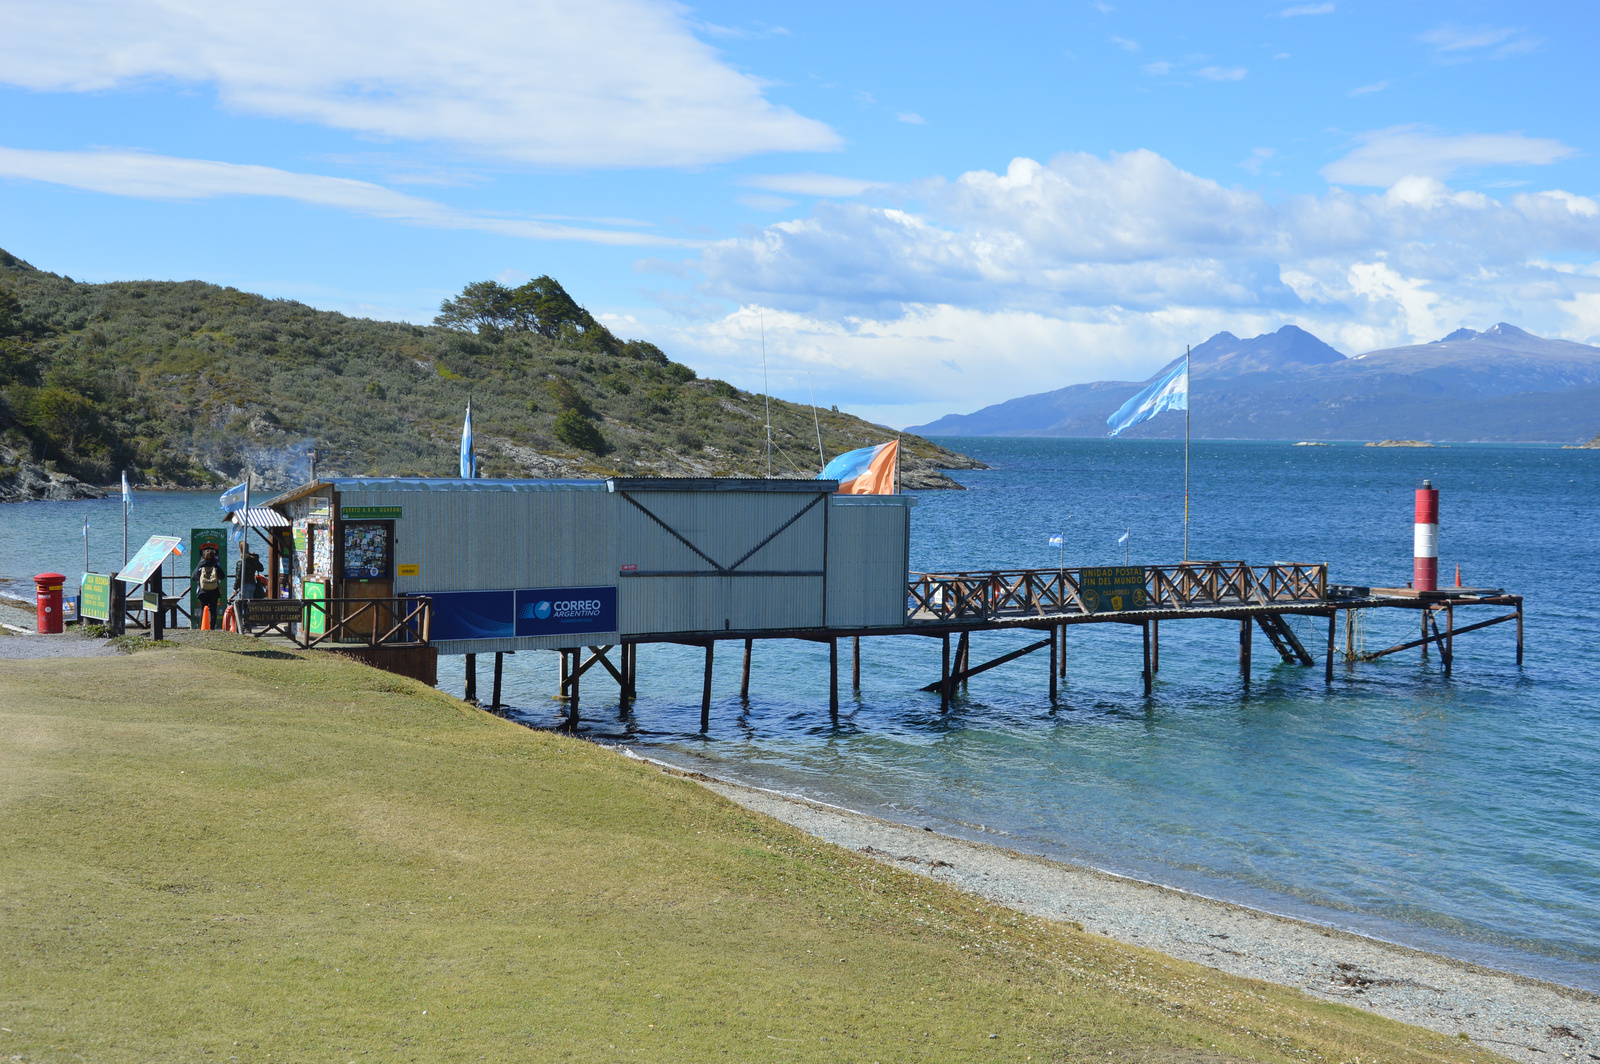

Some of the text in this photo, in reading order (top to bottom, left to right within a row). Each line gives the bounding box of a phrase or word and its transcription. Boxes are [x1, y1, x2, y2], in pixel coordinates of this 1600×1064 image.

[1082, 568, 1143, 577] UNIDAD POSTAL
[1083, 576, 1143, 586] FIN DEL MUNDO
[553, 600, 601, 611] CORREO
[82, 607, 108, 619] ARGENTINA
[552, 609, 600, 618] ARGENTINO
